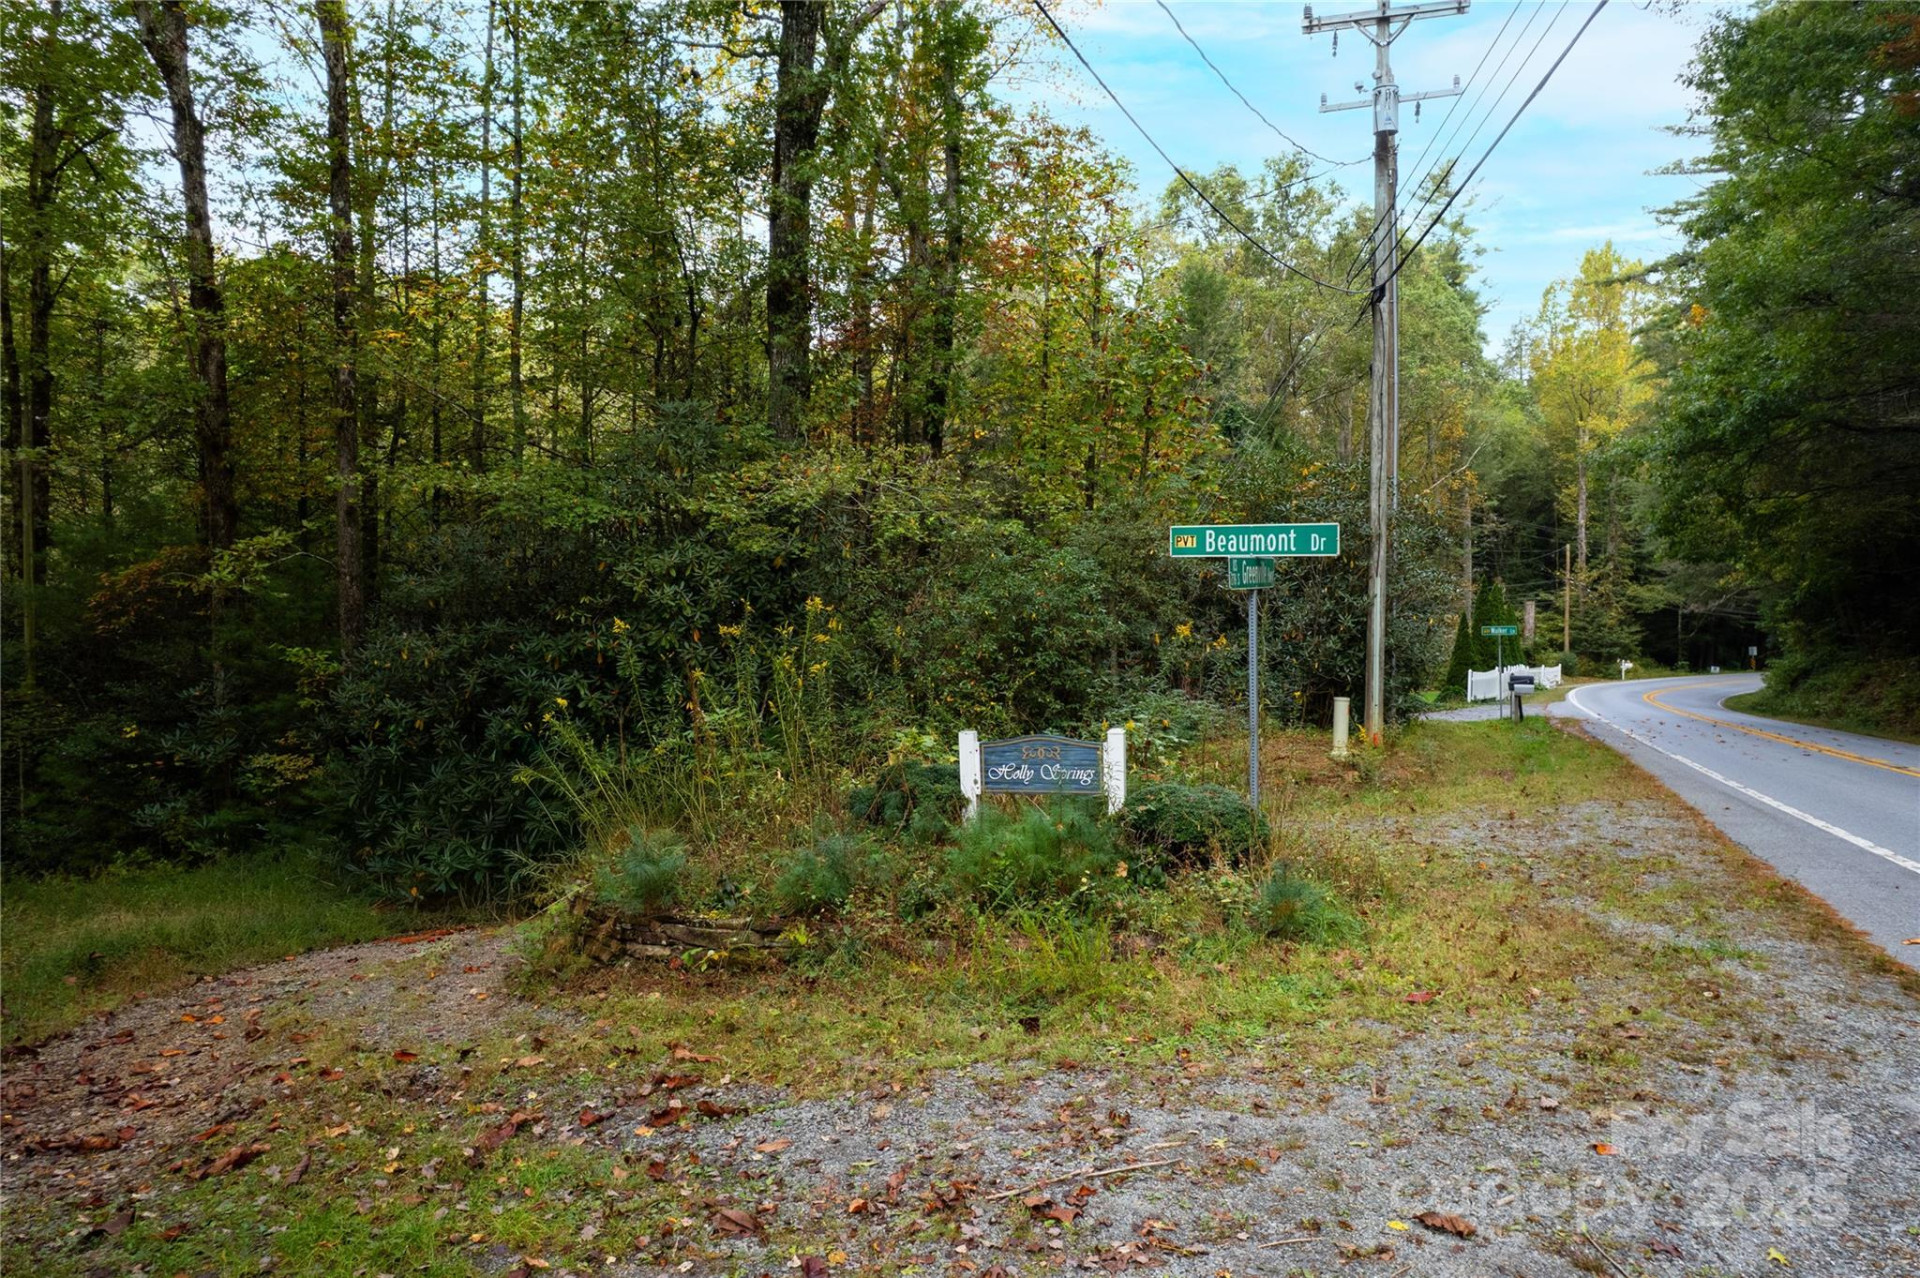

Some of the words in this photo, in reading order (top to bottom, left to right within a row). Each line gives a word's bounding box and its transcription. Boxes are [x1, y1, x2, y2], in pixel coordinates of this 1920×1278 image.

[1175, 535, 1196, 547] PVT
[1205, 529, 1296, 552] Beaumont
[1311, 533, 1326, 551] Dr
[988, 762, 1034, 784] Holly
[1040, 763, 1095, 785] Springs
